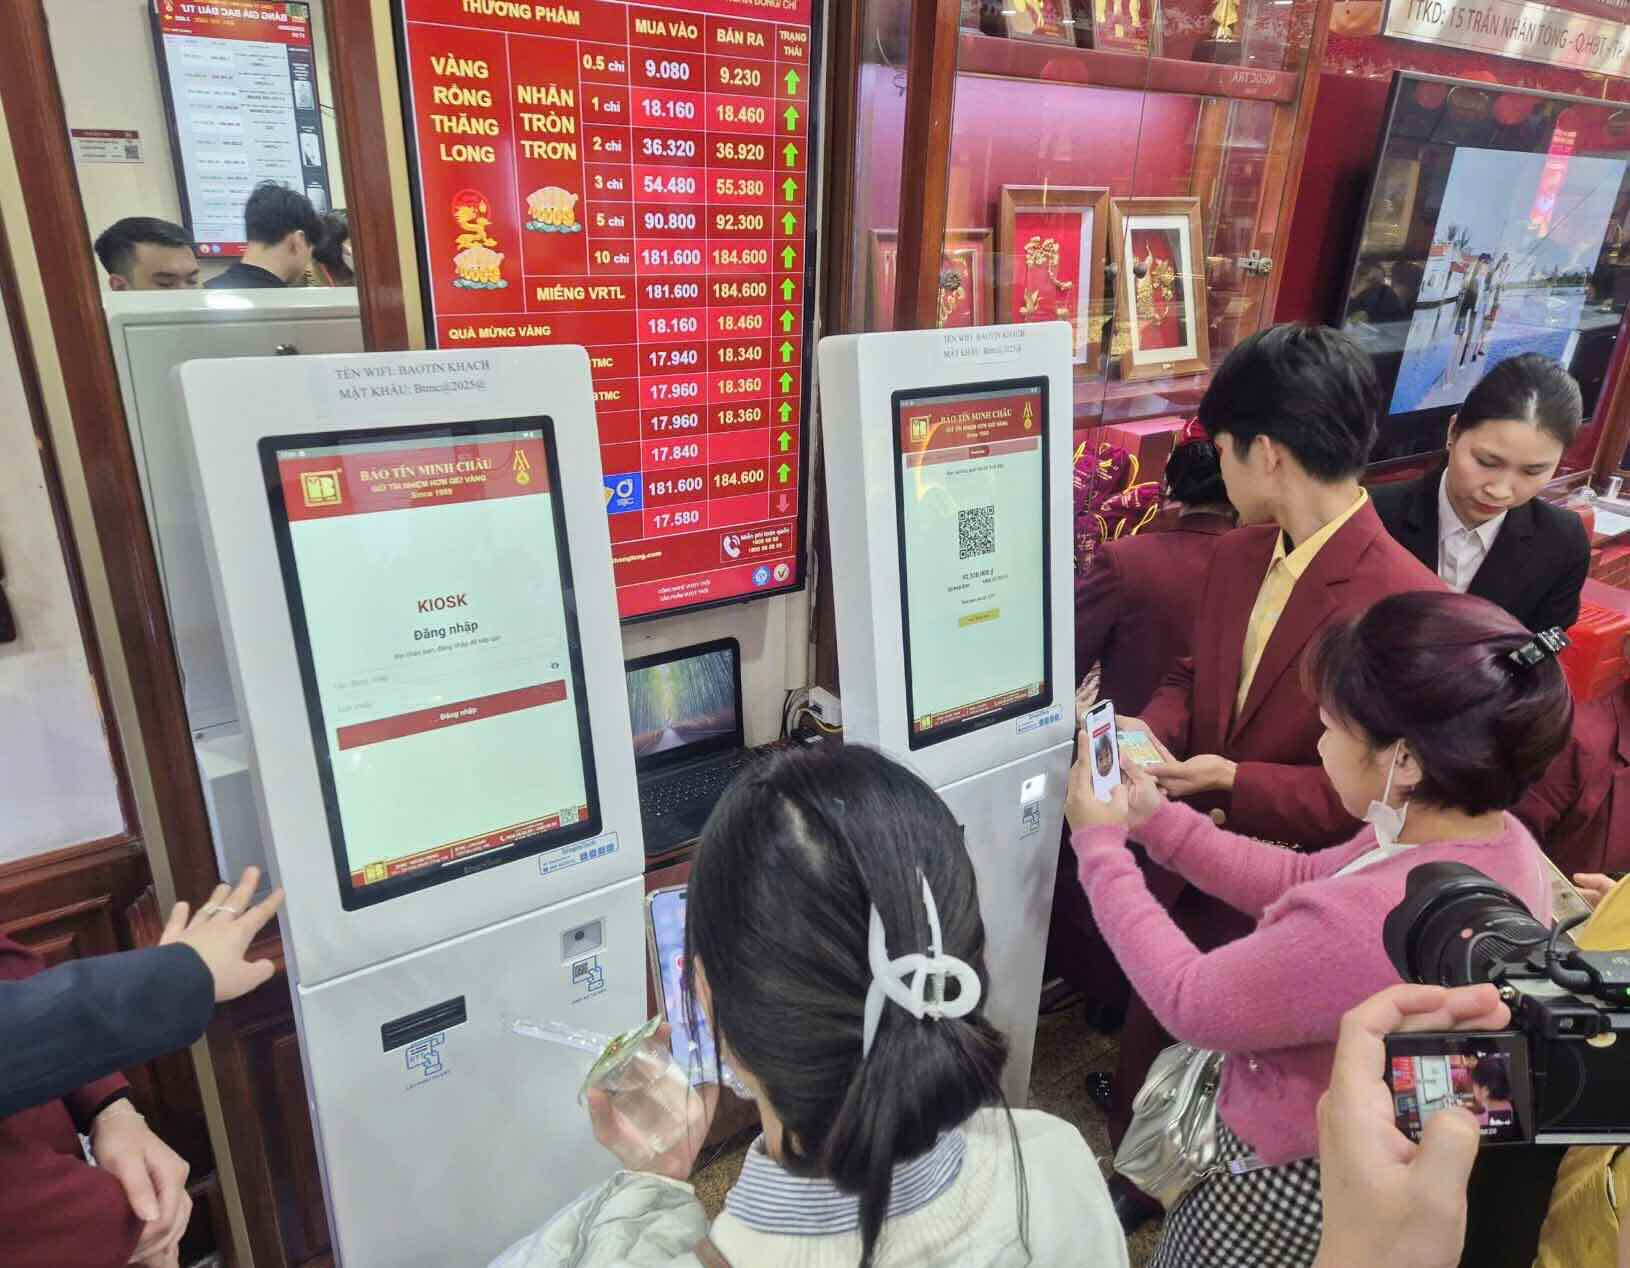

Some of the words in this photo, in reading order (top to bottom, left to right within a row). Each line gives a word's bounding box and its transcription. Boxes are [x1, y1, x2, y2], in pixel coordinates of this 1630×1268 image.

[463, 0, 532, 20] THƯƠNG
[535, 4, 580, 25] PHẨM
[636, 18, 667, 36] MUA
[669, 19, 698, 40] VÀO
[717, 26, 744, 45] BÁN
[747, 31, 765, 47] RA
[779, 30, 807, 43] TRẠNG
[1500, 16, 1535, 44] NHÂN
[784, 44, 802, 57] THÁI
[430, 52, 489, 79] VÀNG
[583, 54, 605, 72] 0.5
[607, 58, 625, 74] chỉ
[646, 60, 689, 81] 9.080
[720, 68, 761, 87] 9.230
[433, 83, 492, 108] RỒNG
[517, 83, 575, 108] NHẪN
[592, 97, 599, 112] 1
[603, 99, 621, 114] chỉ
[642, 99, 695, 120] 18.160
[716, 104, 765, 125] 18.460
[430, 112, 500, 137] THĂNG
[520, 110, 576, 134] TRÒN
[440, 143, 496, 163] LONG
[520, 140, 577, 160] TRƠN
[592, 136, 602, 151] 2
[605, 137, 622, 153] chỉ
[643, 138, 695, 158] 36.320
[716, 142, 764, 161] 36.920
[594, 175, 603, 190] 3
[606, 175, 624, 191] chỉ
[643, 175, 696, 195] 54.480
[716, 178, 764, 197] 55.380
[596, 213, 605, 227] 5
[607, 213, 625, 229] chỉ
[644, 212, 696, 231] 90.800
[715, 213, 764, 231] 92.300
[594, 250, 610, 265] 10
[613, 250, 630, 265] chỉ
[642, 250, 701, 267] 181.600
[712, 248, 767, 266] 184.600
[536, 283, 585, 302] MIẾNG
[588, 285, 625, 300] VRTL
[646, 283, 698, 300] 181.600
[712, 282, 767, 298] 184.600
[449, 326, 477, 340] QUÀ
[478, 325, 516, 338] MỪNG
[518, 325, 551, 337] VÀNG
[648, 317, 697, 335] 18.160
[716, 314, 763, 332] 18.460
[590, 357, 614, 368] TMC
[648, 349, 698, 367] 17.940
[716, 346, 762, 363] 18.340
[649, 381, 698, 399] 17.960
[717, 377, 762, 394] 18.360
[650, 413, 698, 431] 17.960
[717, 407, 761, 424] 18.360
[651, 443, 698, 462] 17.840
[393, 463, 416, 479] TÍN
[418, 462, 455, 477] MINH
[456, 457, 493, 472] CHÂU
[648, 477, 703, 497] 181.600
[713, 469, 764, 488] 184.600
[653, 510, 700, 529] 17.580
[417, 593, 467, 613] KIOSK
[413, 626, 446, 641] Đăng
[450, 620, 479, 635] nhập
